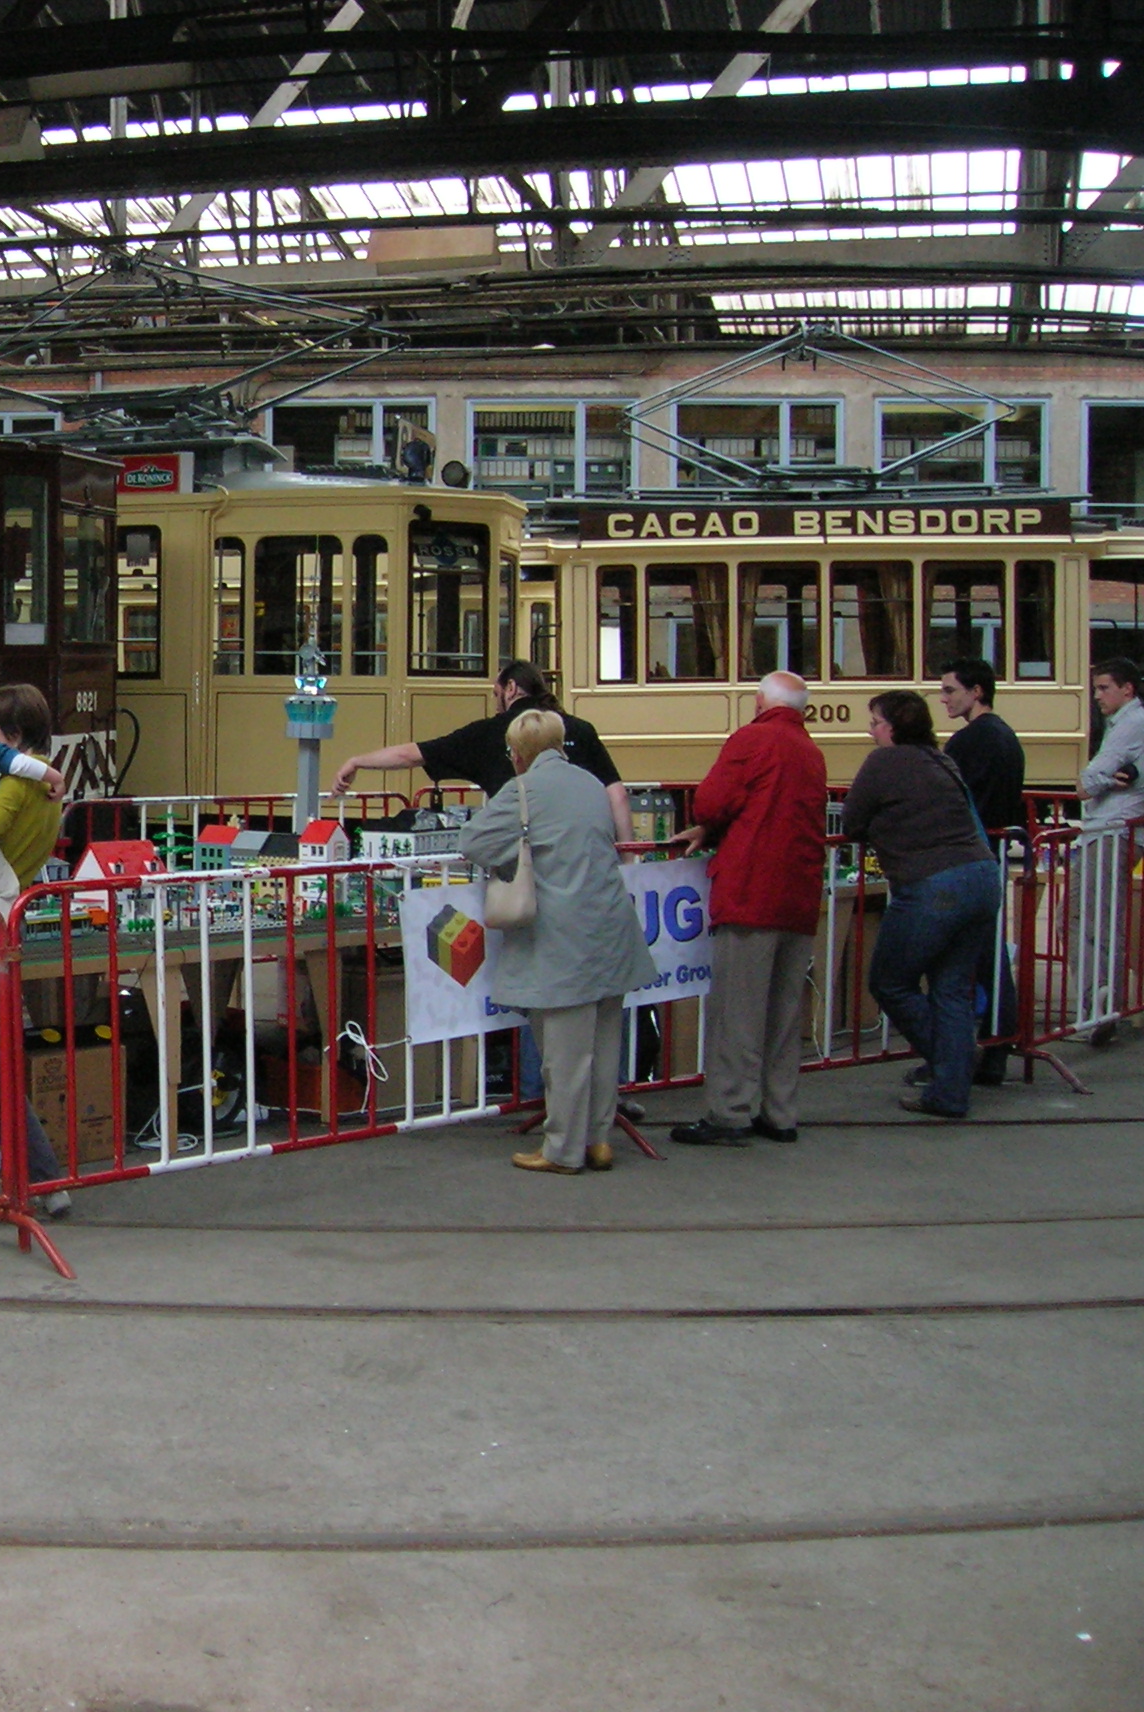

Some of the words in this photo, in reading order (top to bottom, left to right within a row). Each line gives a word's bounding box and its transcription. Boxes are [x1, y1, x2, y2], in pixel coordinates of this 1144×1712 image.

[607, 511, 760, 538] CACAO
[793, 508, 1043, 535] BENSDORP
[76, 691, 97, 712] 8821
